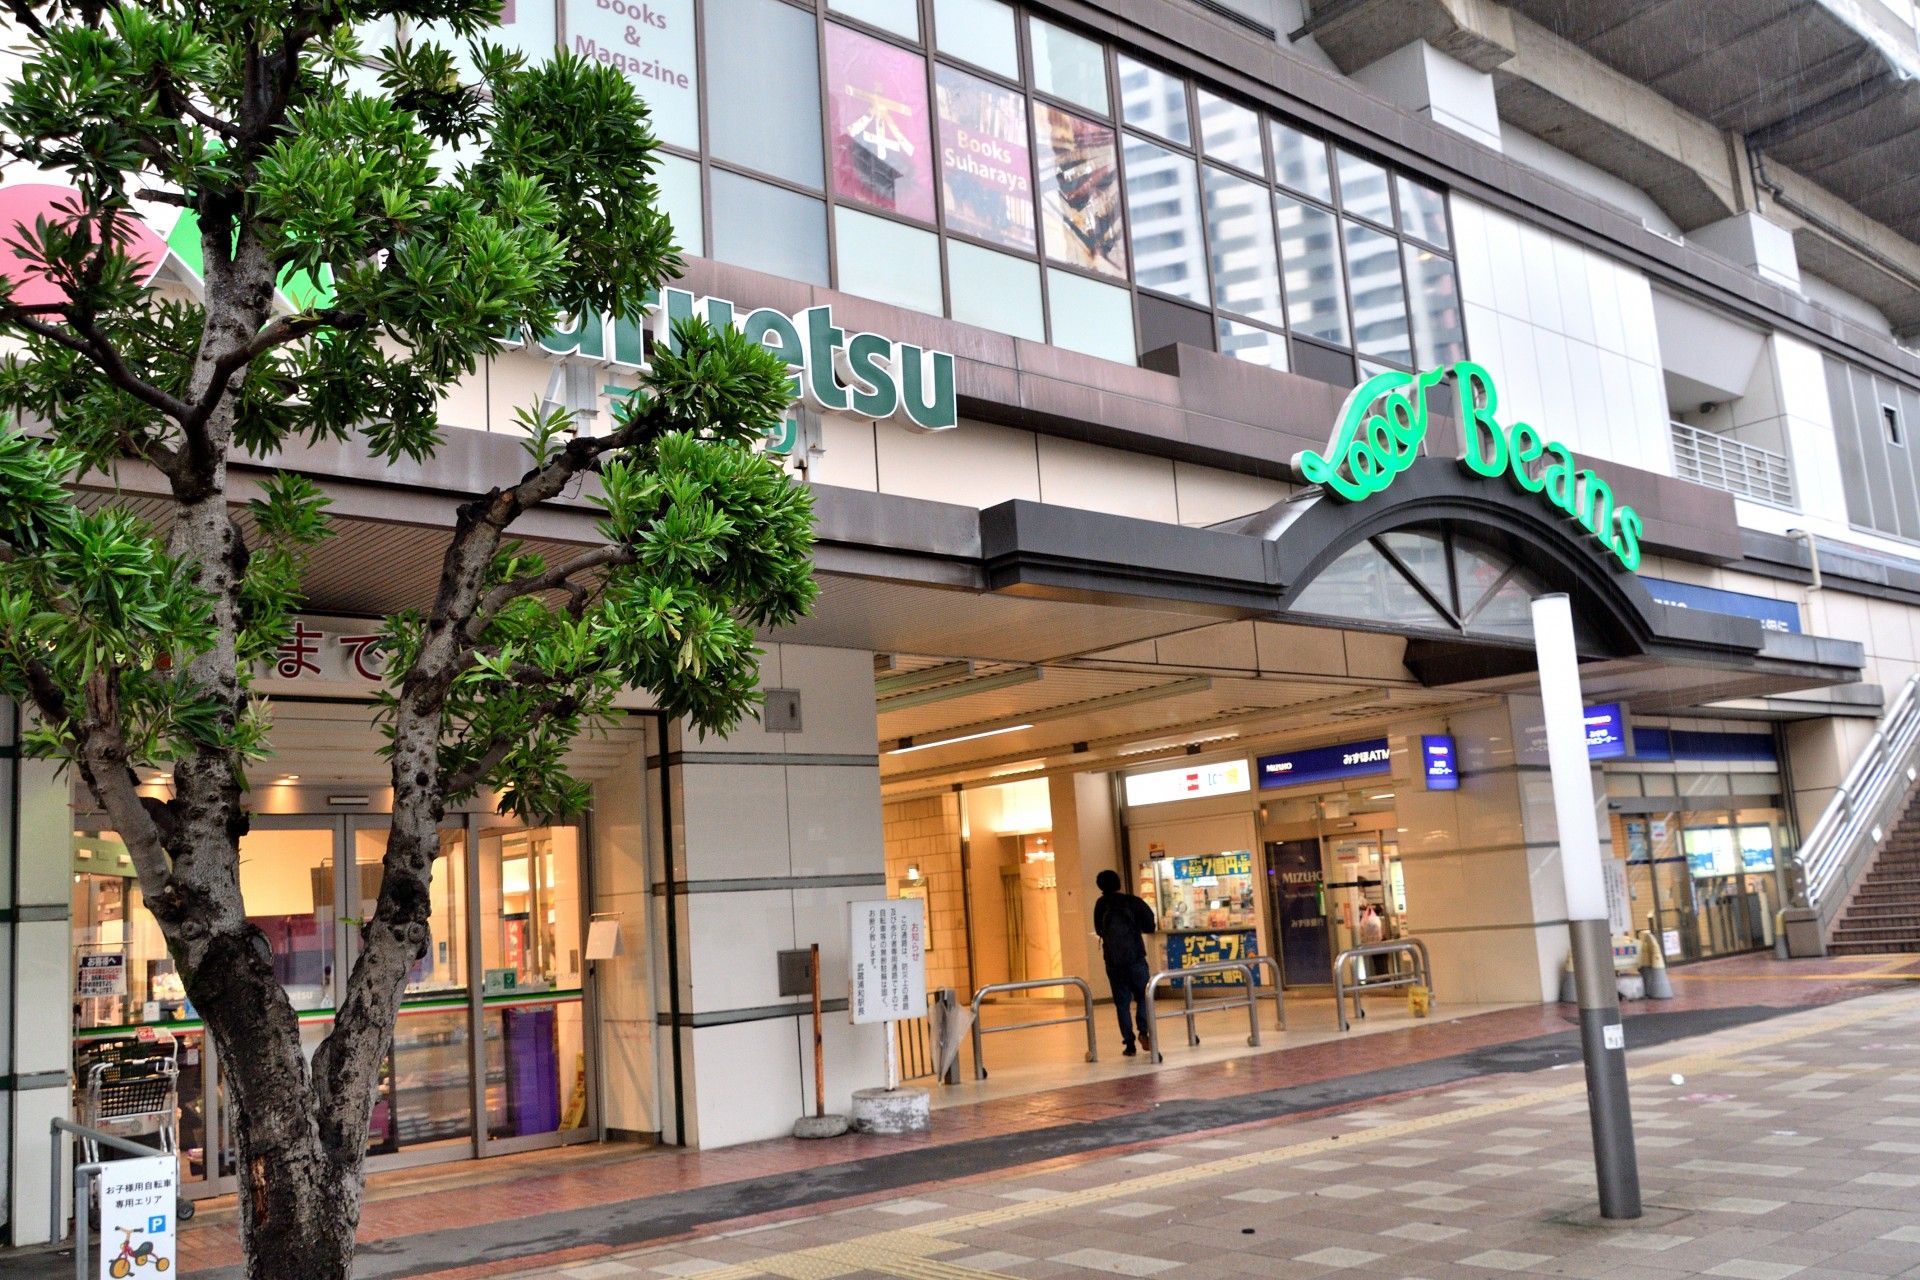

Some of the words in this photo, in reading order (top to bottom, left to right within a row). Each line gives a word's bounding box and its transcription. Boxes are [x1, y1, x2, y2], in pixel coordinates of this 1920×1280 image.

[596, 0, 667, 30] Books
[624, 25, 642, 47] &
[575, 34, 689, 89] Magazine
[957, 128, 1013, 164] Books
[944, 147, 1027, 192] Suharaya
[1454, 360, 1643, 572] Beans
[276, 621, 387, 683] まで
[911, 923, 919, 962] お知らせ
[106, 1179, 171, 1195] お子様用自転車
[115, 1195, 162, 1209] 専用エリア
